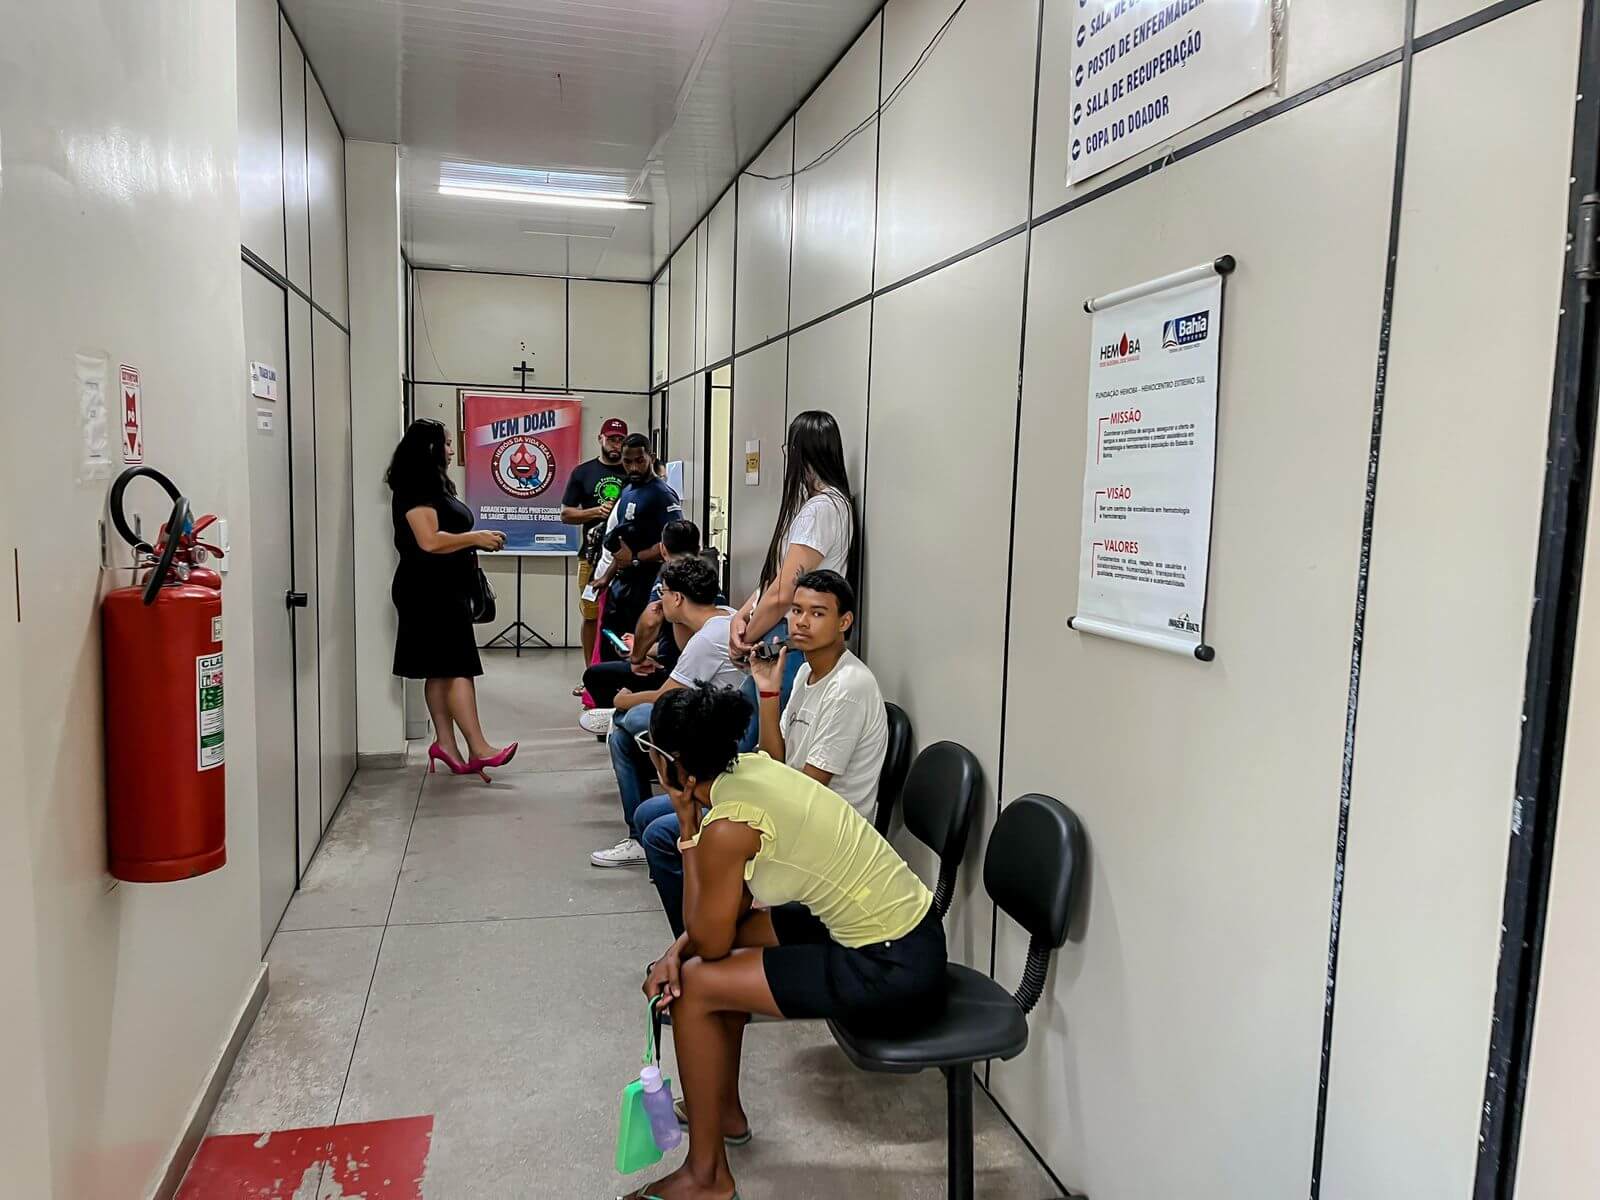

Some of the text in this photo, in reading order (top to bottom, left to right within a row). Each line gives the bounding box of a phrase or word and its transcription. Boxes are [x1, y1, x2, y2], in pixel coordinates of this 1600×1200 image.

[1088, 44, 1115, 78] POSTO
[1119, 33, 1130, 57] DE
[1087, 30, 1201, 116] SALA DE RECUPERAÇÃO
[1086, 96, 1169, 154] COPA DO DOADOR
[1179, 316, 1206, 336] Bahia
[492, 410, 555, 440] VEM DOAR
[1110, 408, 1141, 424] MISSÃO
[525, 437, 539, 446] VIDA
[540, 444, 552, 459] REAL
[1107, 484, 1131, 499] VISÃO
[1104, 539, 1138, 554] VALORES
